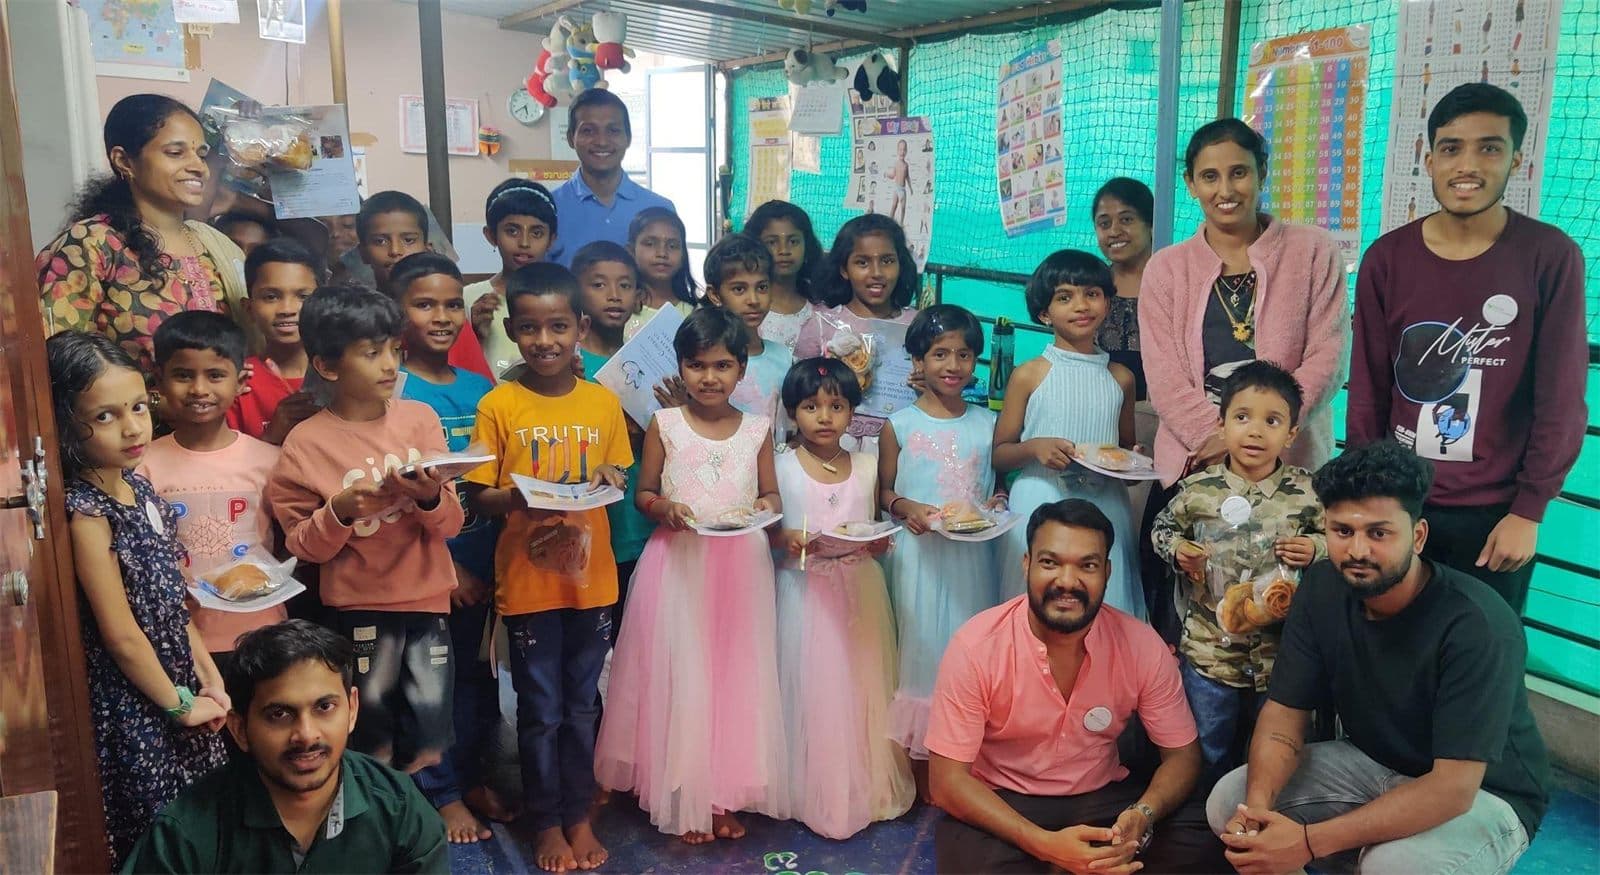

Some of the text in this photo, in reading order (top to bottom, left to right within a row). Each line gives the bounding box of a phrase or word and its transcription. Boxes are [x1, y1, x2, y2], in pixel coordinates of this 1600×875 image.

[1417, 316, 1511, 367] Mister
[1461, 357, 1506, 366] PERFECT
[515, 425, 599, 447] TRUTH
[228, 498, 248, 524] P
